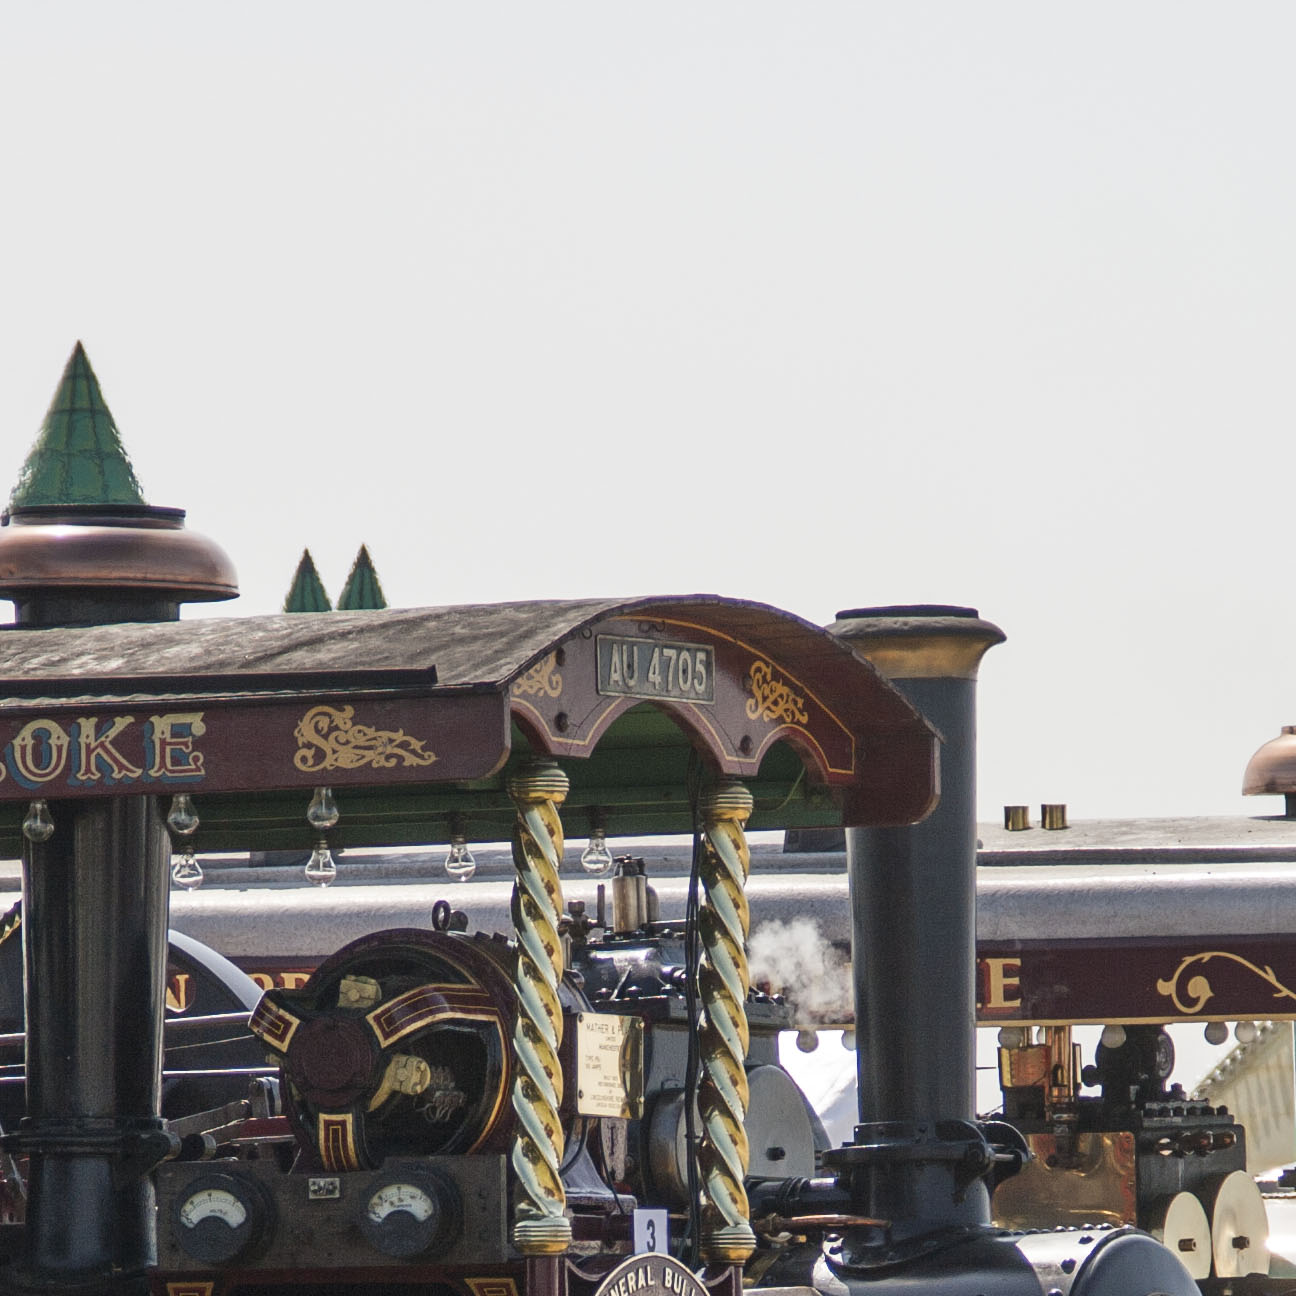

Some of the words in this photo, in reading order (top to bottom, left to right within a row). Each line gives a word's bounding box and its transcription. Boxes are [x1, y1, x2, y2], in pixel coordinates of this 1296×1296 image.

[609, 643, 638, 687] AU
[648, 647, 707, 694] 4705
[646, 1219, 656, 1252] 3
